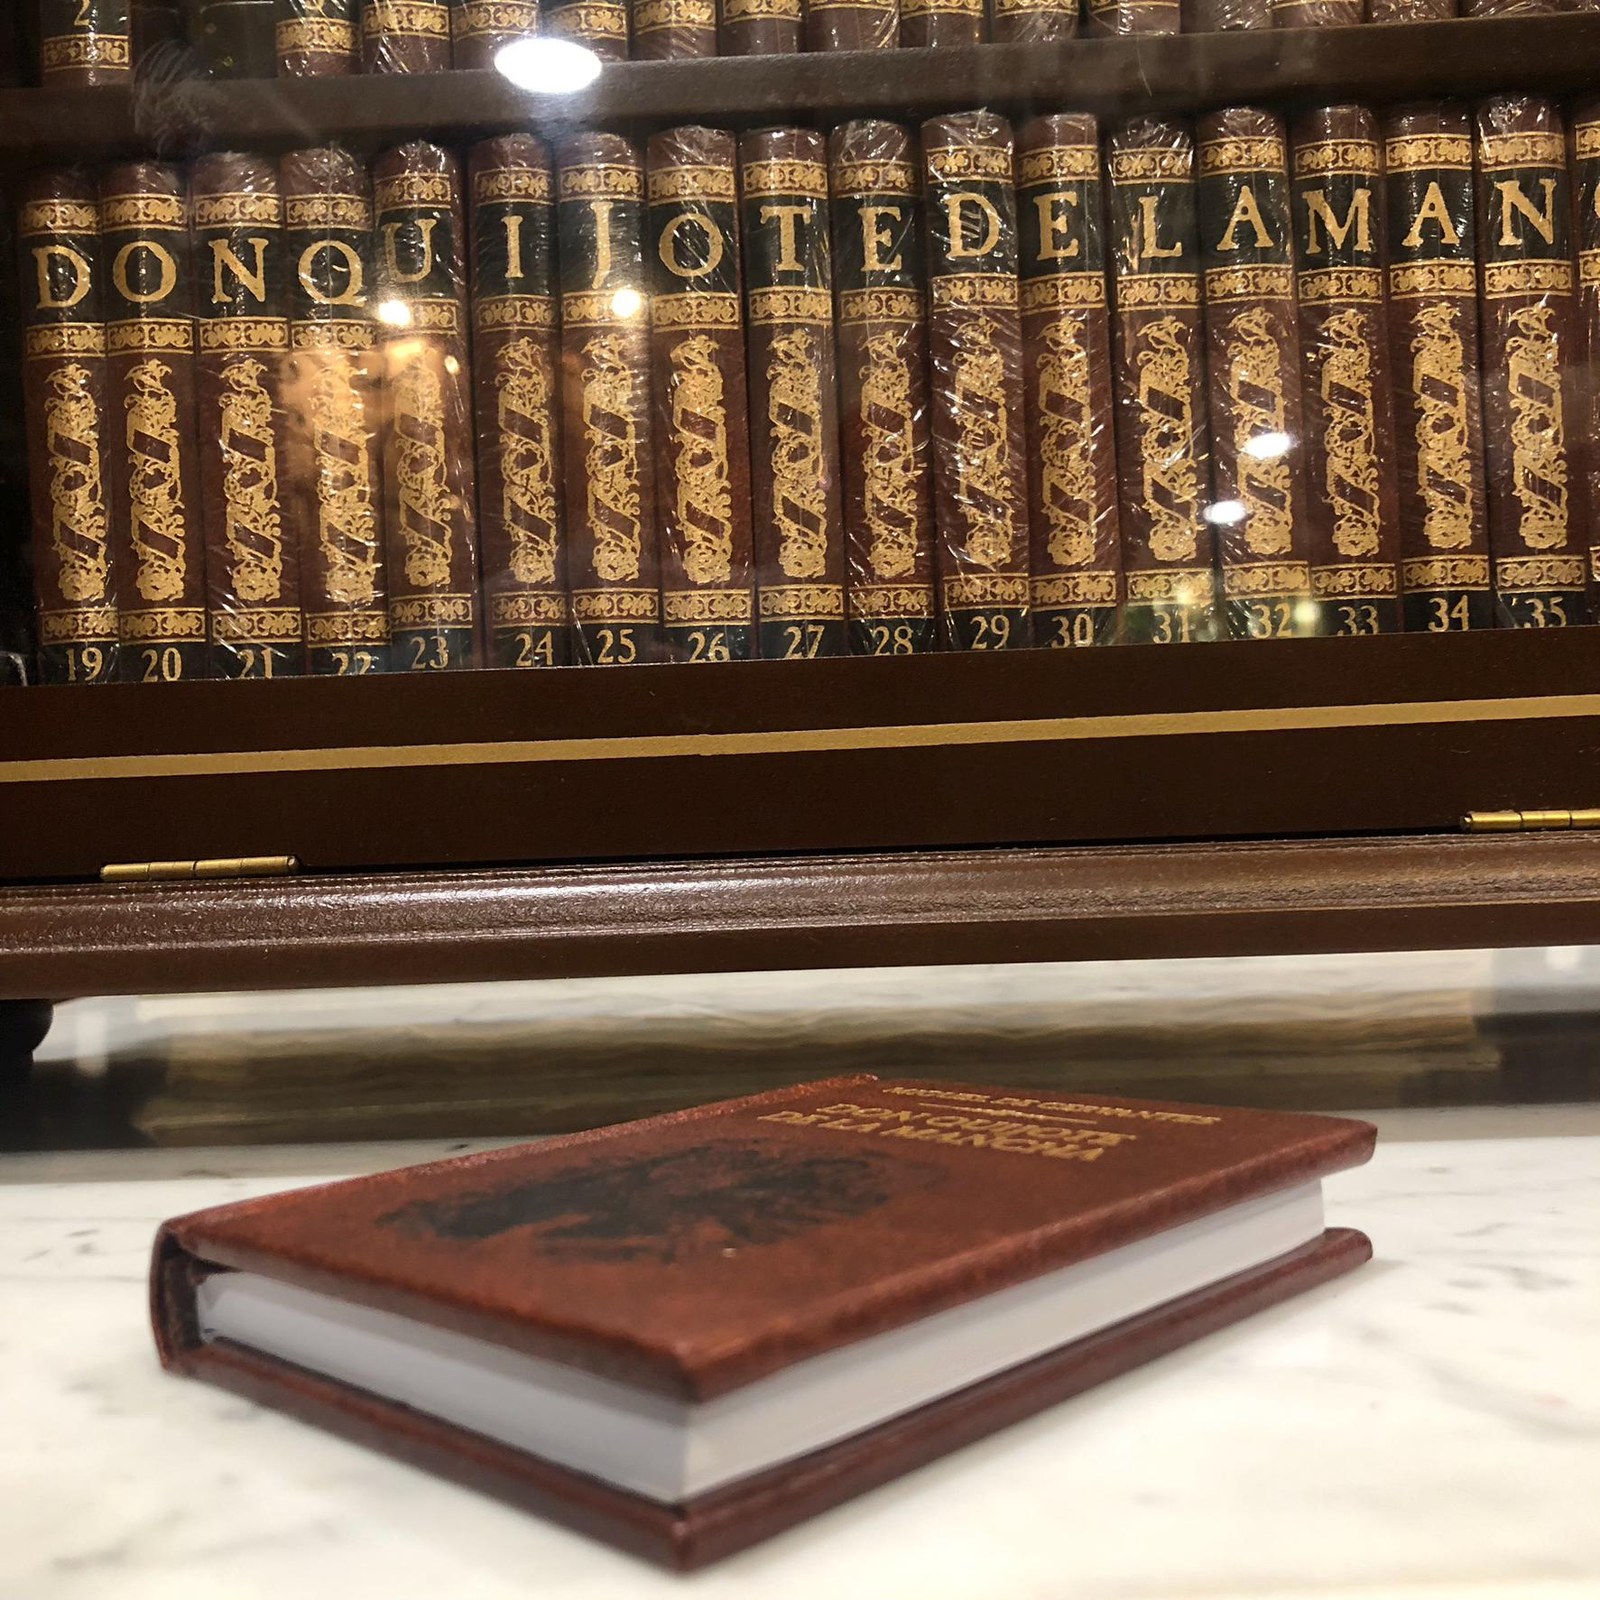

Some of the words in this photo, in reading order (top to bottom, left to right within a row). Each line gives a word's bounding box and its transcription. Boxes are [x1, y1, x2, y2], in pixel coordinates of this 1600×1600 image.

[1152, 608, 1183, 644] 31
[1251, 602, 1294, 639] 32
[1338, 605, 1380, 636] 33
[1428, 595, 1469, 632] 34
[1524, 597, 1567, 628] 35
[597, 628, 636, 664] 25
[688, 631, 731, 663] 26
[783, 624, 826, 659] 27
[873, 625, 913, 655] 28
[970, 614, 1010, 649] 29
[1051, 613, 1094, 647] 30
[66, 647, 103, 681] 19
[141, 647, 182, 682] 20
[239, 648, 273, 679] 21
[410, 635, 449, 669] 23
[515, 629, 554, 666] 24
[816, 1103, 932, 1121] DON
